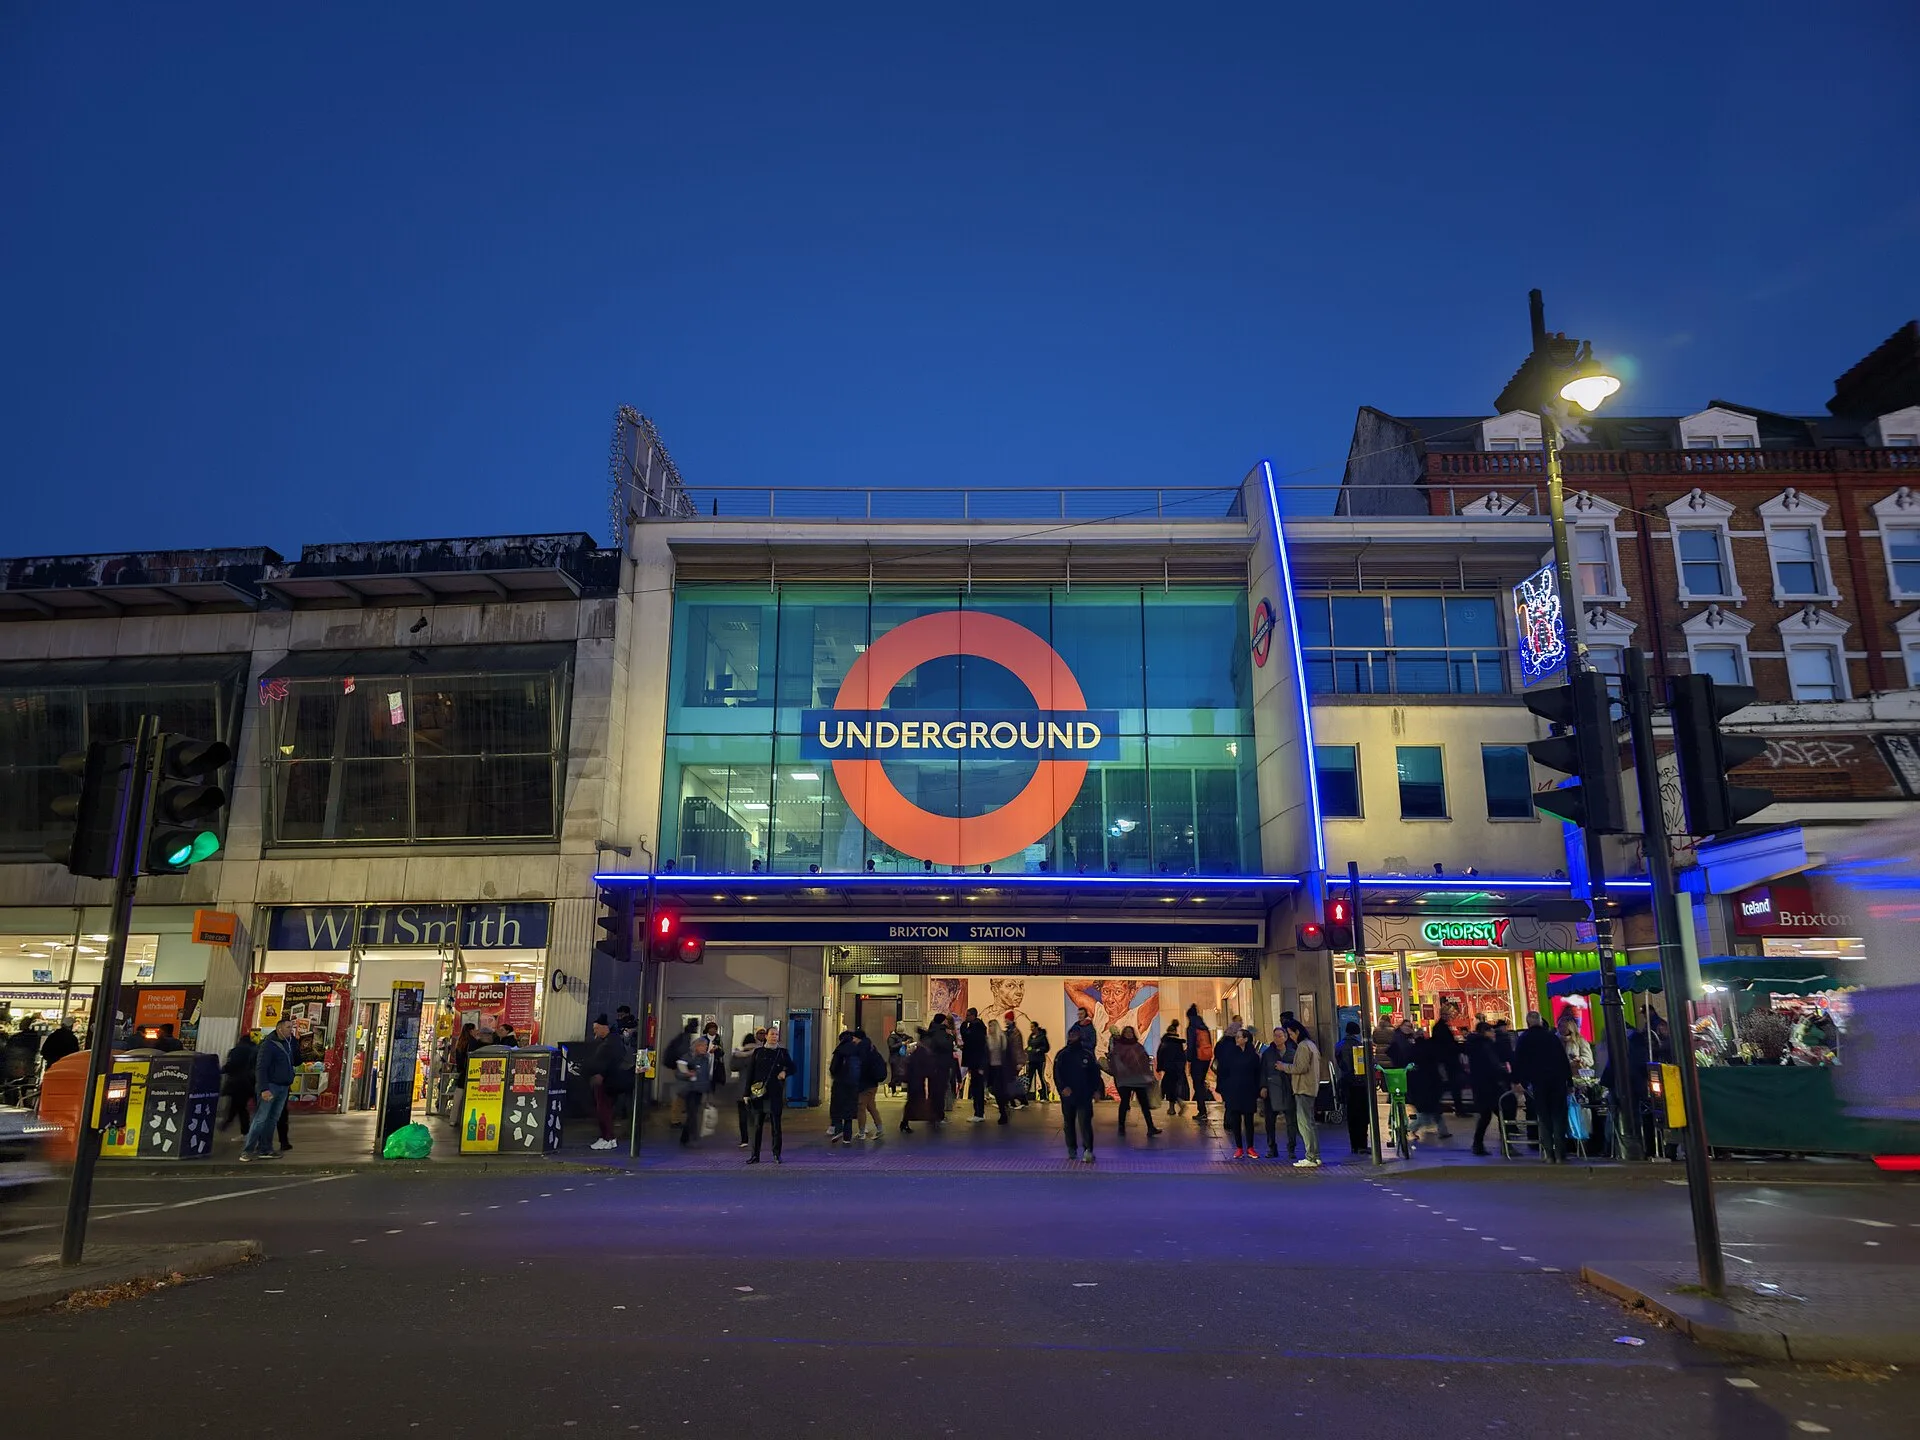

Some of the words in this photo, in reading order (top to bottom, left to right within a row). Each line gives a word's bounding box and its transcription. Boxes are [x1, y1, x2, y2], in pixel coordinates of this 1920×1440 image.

[819, 721, 1101, 749] UNDERGROUND
[1741, 898, 1771, 916] Iceland
[1779, 911, 1854, 926] Brixton
[302, 906, 522, 949] WHSmith
[889, 926, 949, 938] BRIXTON
[970, 926, 1026, 938] STATION
[1424, 919, 1510, 947] CHOPSTIX
[286, 985, 309, 993] Great
[310, 985, 332, 993] value
[457, 990, 477, 999] half
[478, 990, 504, 1000] price
